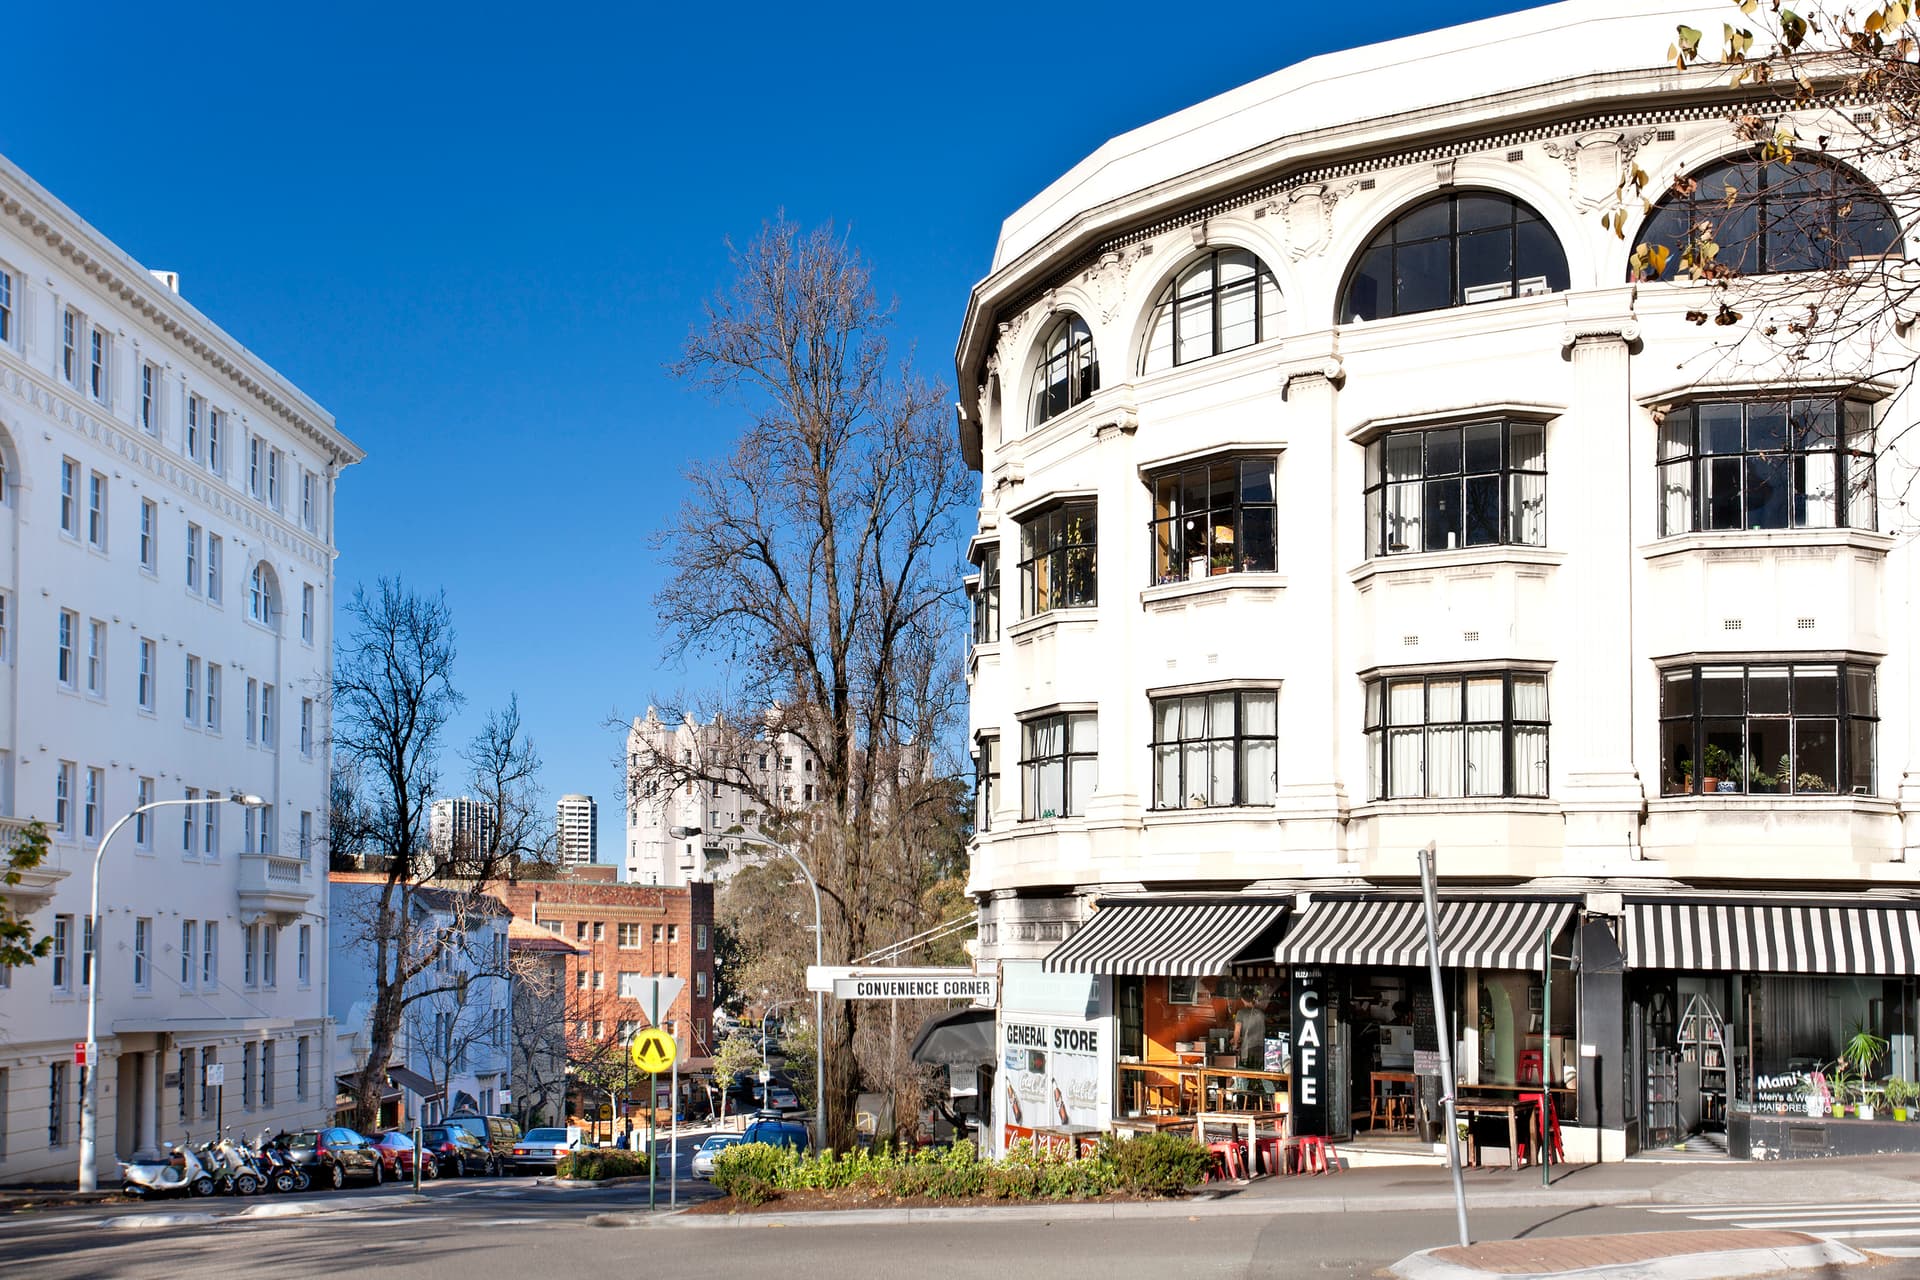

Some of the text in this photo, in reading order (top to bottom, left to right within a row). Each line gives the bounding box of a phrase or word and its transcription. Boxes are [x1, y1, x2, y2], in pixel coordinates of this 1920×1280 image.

[857, 981, 990, 996] CONVENIENCE CORNER
[1006, 1024, 1097, 1051] GENERAL STORE
[1298, 991, 1320, 1104] CAFE
[1757, 1070, 1812, 1089] Mami's
